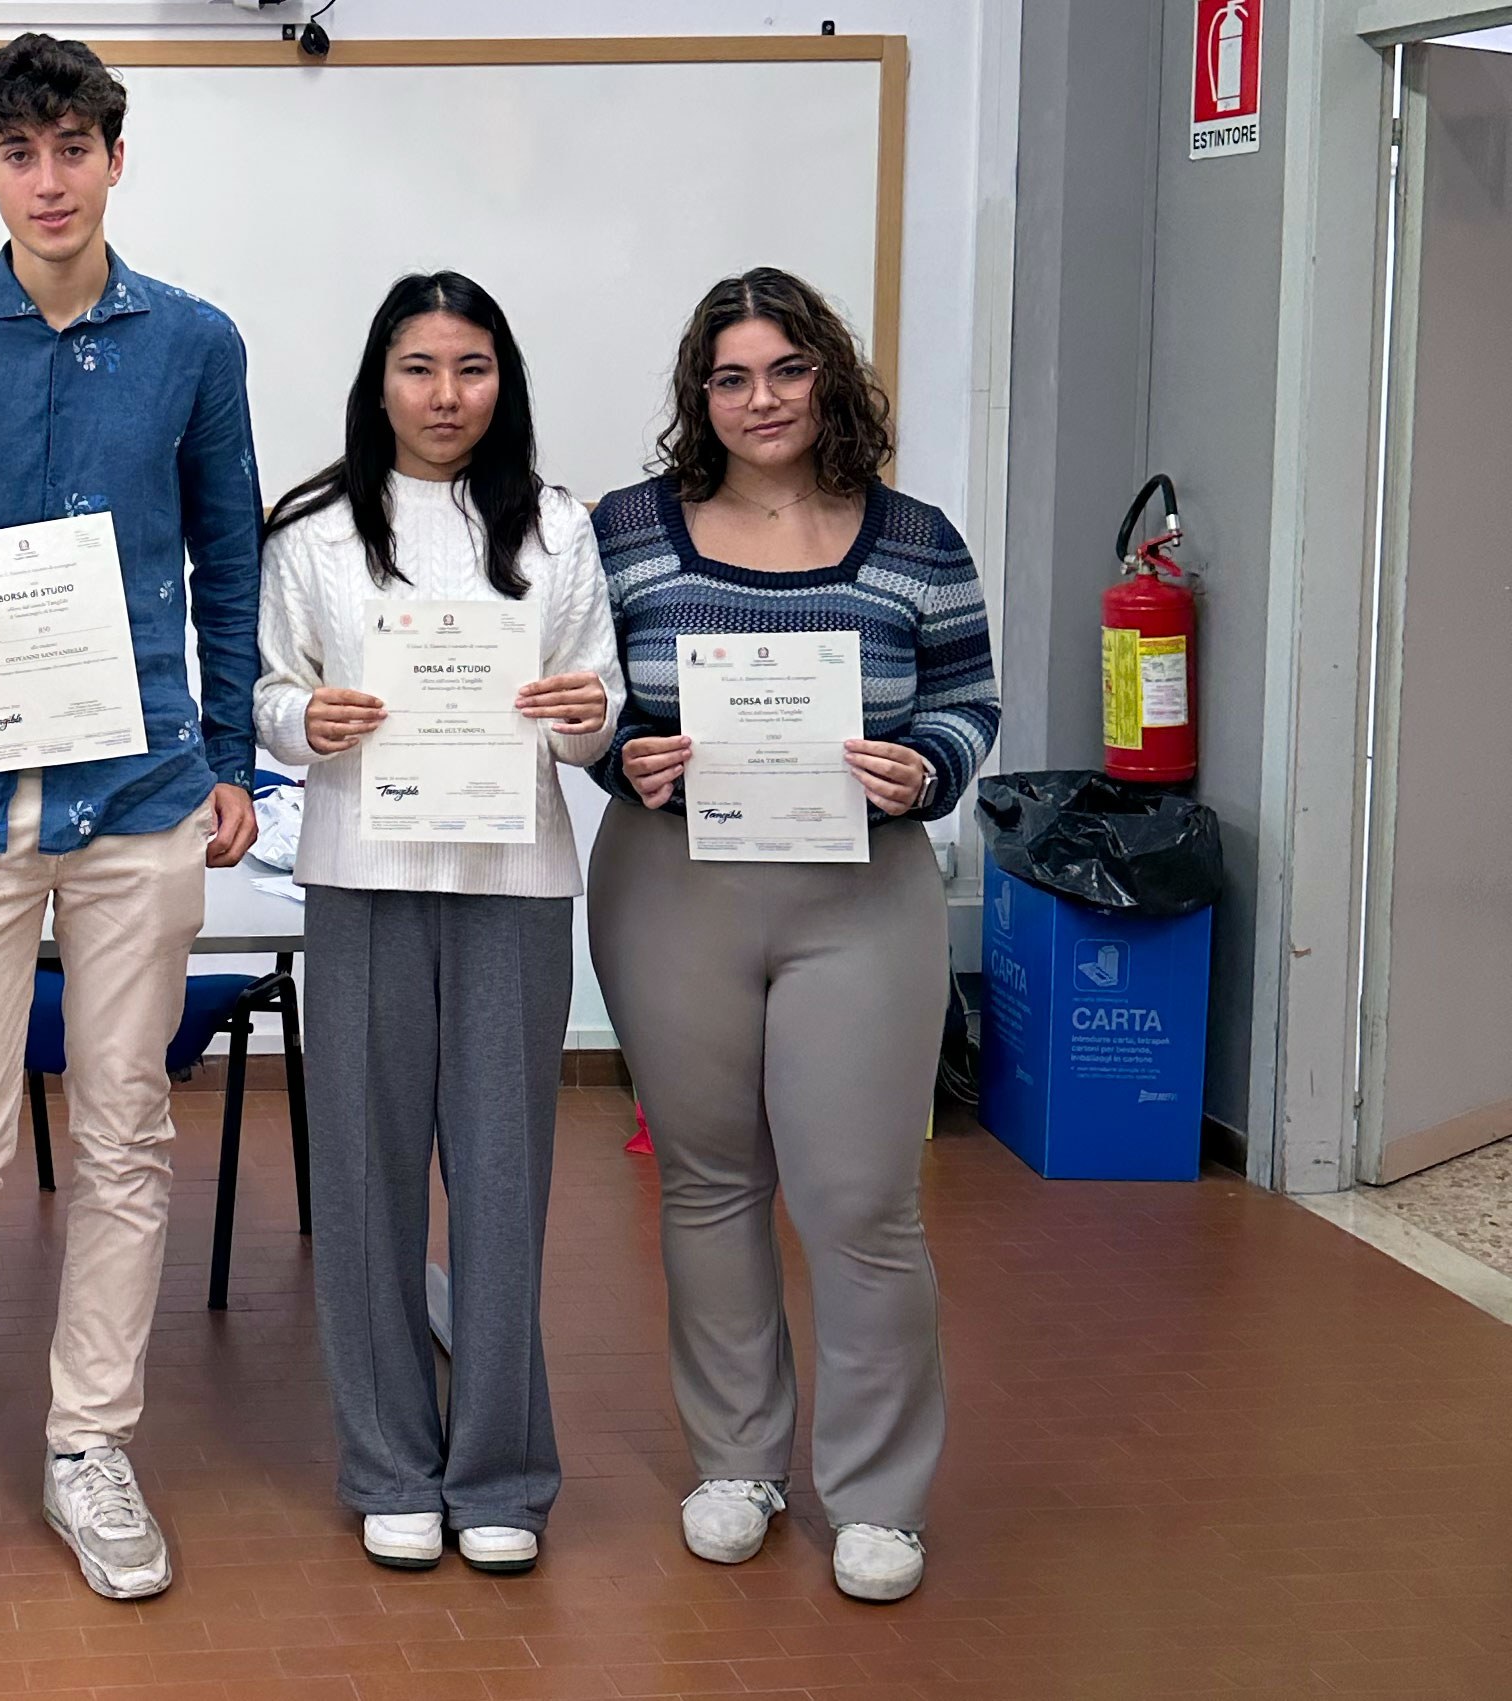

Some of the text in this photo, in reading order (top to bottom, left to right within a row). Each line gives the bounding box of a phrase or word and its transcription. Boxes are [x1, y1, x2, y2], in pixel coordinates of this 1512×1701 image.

[1193, 124, 1257, 150] ESTINTORE
[30, 588, 38, 598] di
[40, 584, 74, 597] STUDIO
[413, 665, 491, 673] BORSA di STUDIO
[729, 696, 810, 705] BORSA di STUDIO
[376, 784, 419, 801] Tangible
[699, 808, 743, 824] Tangible
[991, 949, 1027, 995] CARTA
[1072, 1007, 1162, 1031] CARTA
